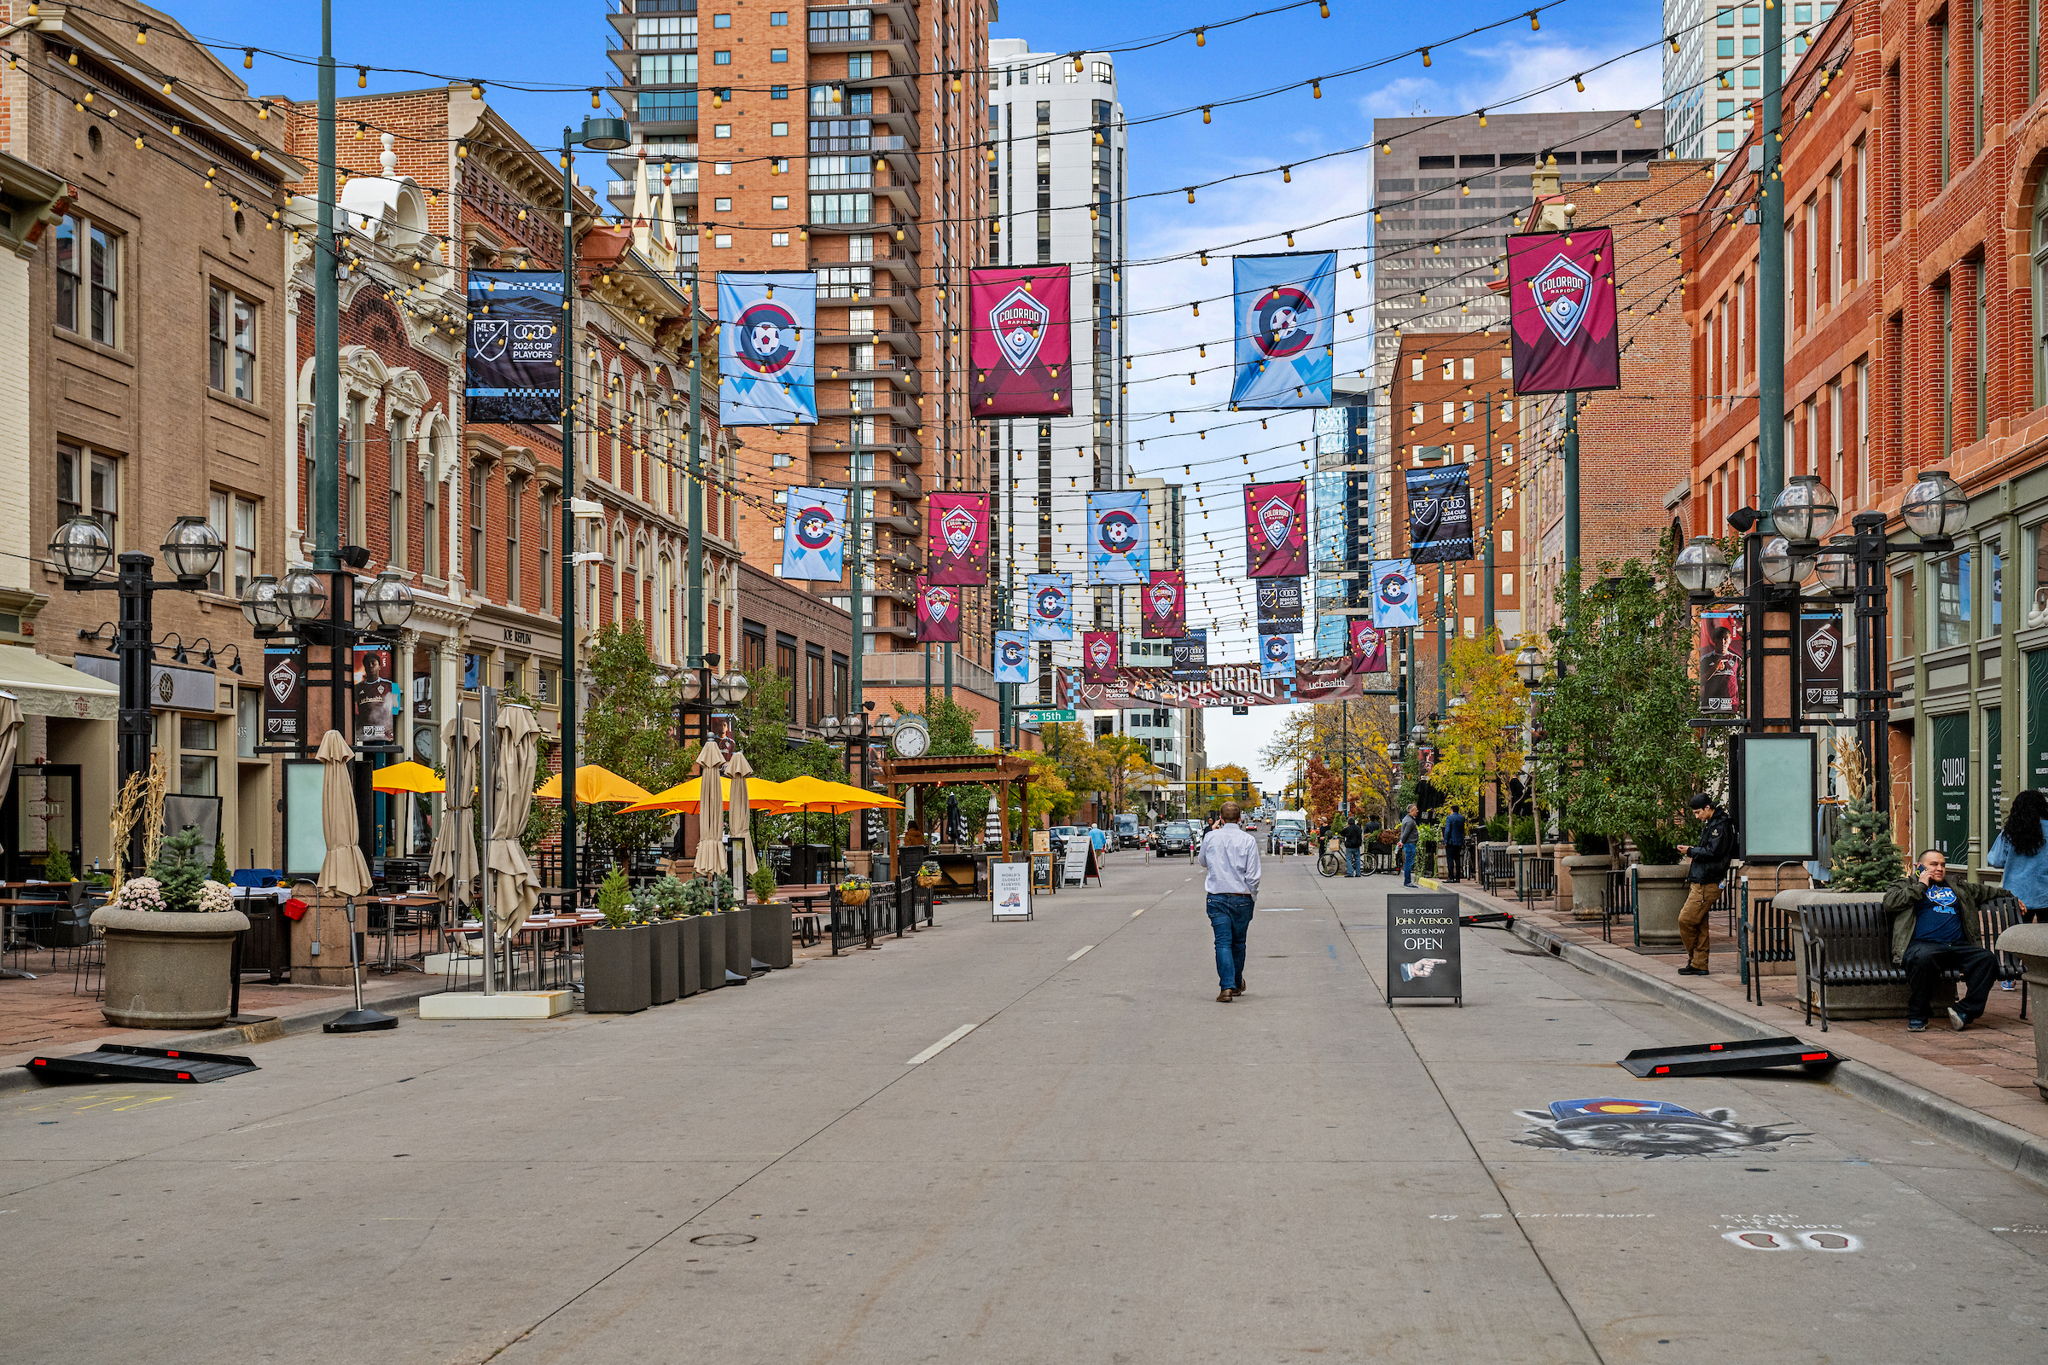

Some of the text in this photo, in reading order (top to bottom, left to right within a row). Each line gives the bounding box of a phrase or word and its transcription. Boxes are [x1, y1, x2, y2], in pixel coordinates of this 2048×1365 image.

[1541, 276, 1583, 292] COLORADO
[1000, 308, 1039, 322] COLORADO
[476, 323, 496, 332] MLS
[513, 342, 553, 350] 2024 CUP
[512, 351, 553, 359] PLAYOFFS
[503, 628, 513, 641] JOE
[1308, 677, 1346, 689] uchealth
[1198, 696, 1256, 706] RAPIDS
[1042, 712, 1061, 720] 15th
[1942, 757, 1966, 787] SWAY
[1395, 917, 1415, 926] JOHN
[1404, 937, 1443, 950] OPEN
